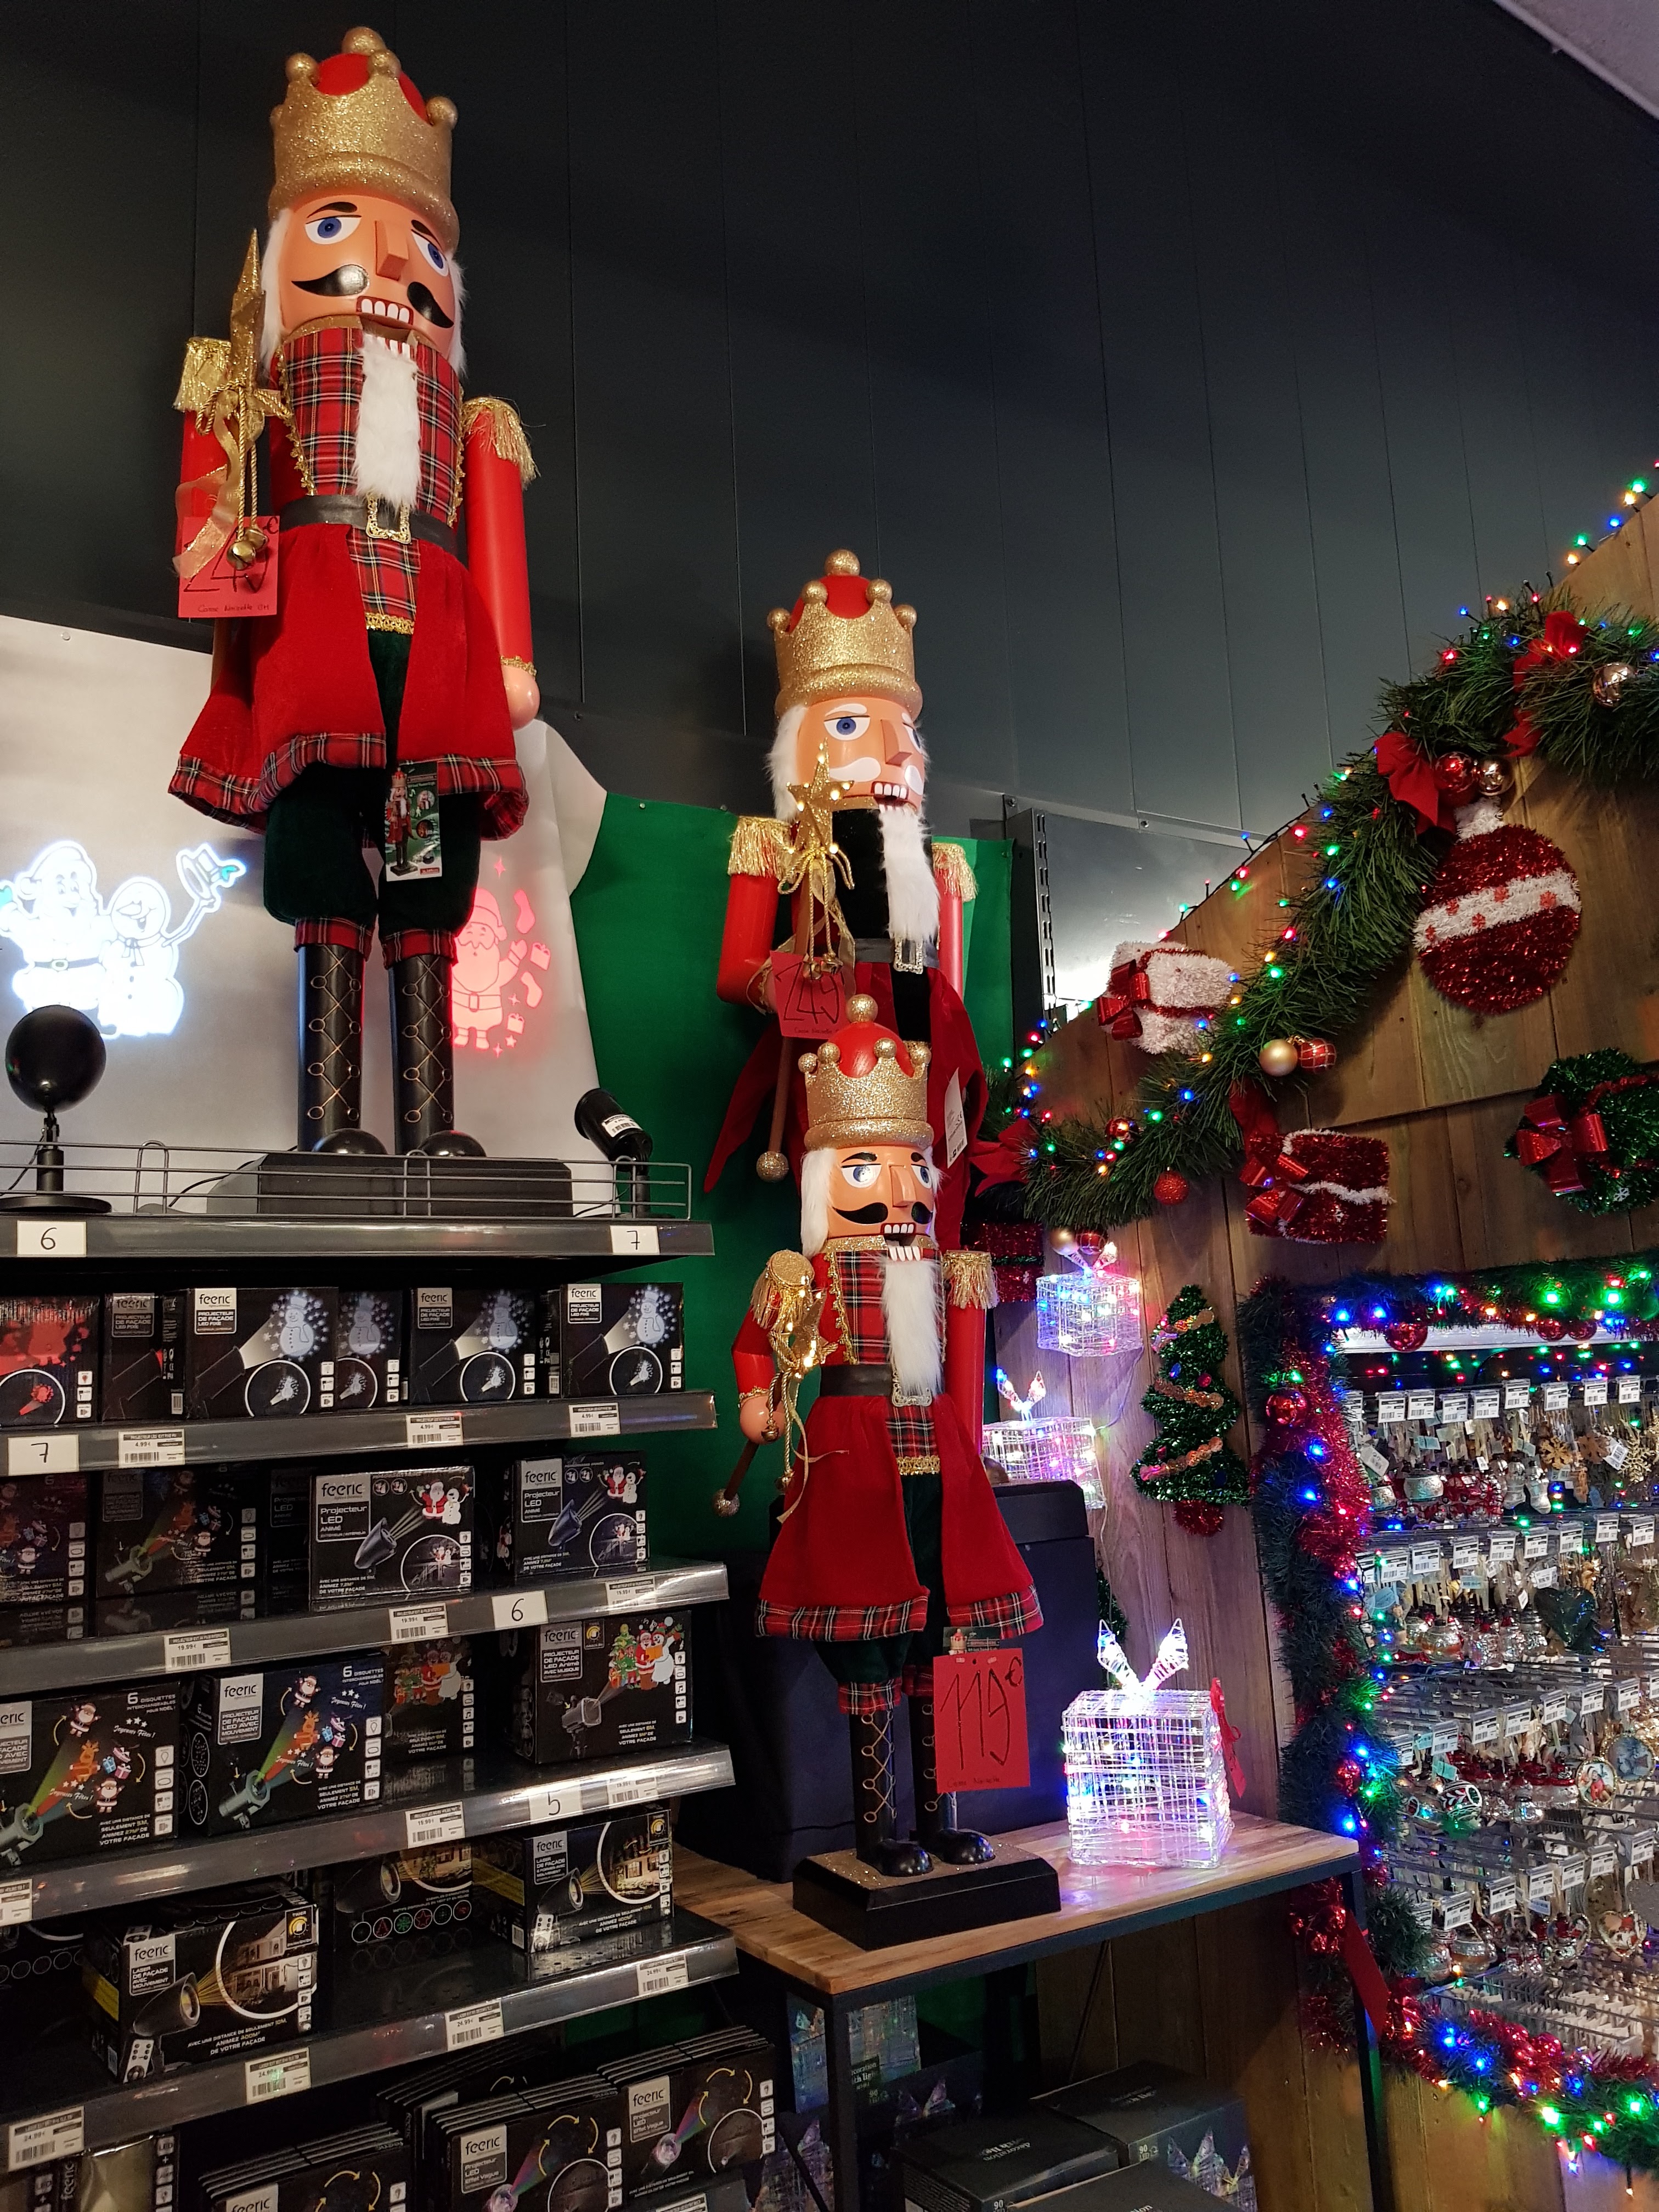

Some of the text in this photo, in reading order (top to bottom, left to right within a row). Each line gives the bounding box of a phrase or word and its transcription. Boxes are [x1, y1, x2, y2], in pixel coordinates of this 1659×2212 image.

[41, 1227, 57, 1250] 6
[627, 1230, 640, 1250] 7
[421, 1293, 448, 1302] feeric
[572, 1288, 597, 1297] feeric
[199, 1294, 230, 1304] feeric
[31, 1442, 48, 1463] 7
[525, 1471, 556, 1483] feeric
[321, 1483, 362, 1497] feeric
[524, 1491, 560, 1499] Projecteur
[524, 1499, 542, 1508] LED
[320, 1506, 368, 1515] Projecteur
[320, 1515, 343, 1525] LED
[511, 1598, 524, 1621] 6
[545, 1629, 576, 1642] feeric
[343, 1666, 352, 1678] 6
[224, 1685, 256, 1697] feeric
[127, 1692, 176, 1705] 6 DISQUETTES
[222, 1709, 259, 1719] PROJECTEUR
[222, 1726, 258, 1736] MOUVEMENT
[317, 1798, 360, 1810] VOTRE FAÇADE
[548, 1791, 561, 1815] 5
[101, 1822, 136, 1832] SEULEMENT
[99, 1832, 150, 1847] VOTRE FAÇADE
[101, 1831, 125, 1839] ANIMEZ
[537, 1840, 563, 1852] feeric
[134, 1945, 168, 1961] feeric
[133, 1977, 169, 1989] MOUVEMENT
[216, 2036, 240, 2047] ANIMEZ
[220, 2042, 240, 2052] VOTRE
[241, 2036, 266, 2047] FAÇADE
[633, 2089, 664, 2107] feeric
[633, 2107, 661, 2120] Projecteur
[633, 2119, 646, 2127] LED
[465, 2137, 500, 2155] feeric
[1139, 2144, 1148, 2154] 90
[465, 2157, 497, 2170] Projecteur
[465, 2168, 479, 2177] LED
[994, 2199, 1004, 2210] 90
